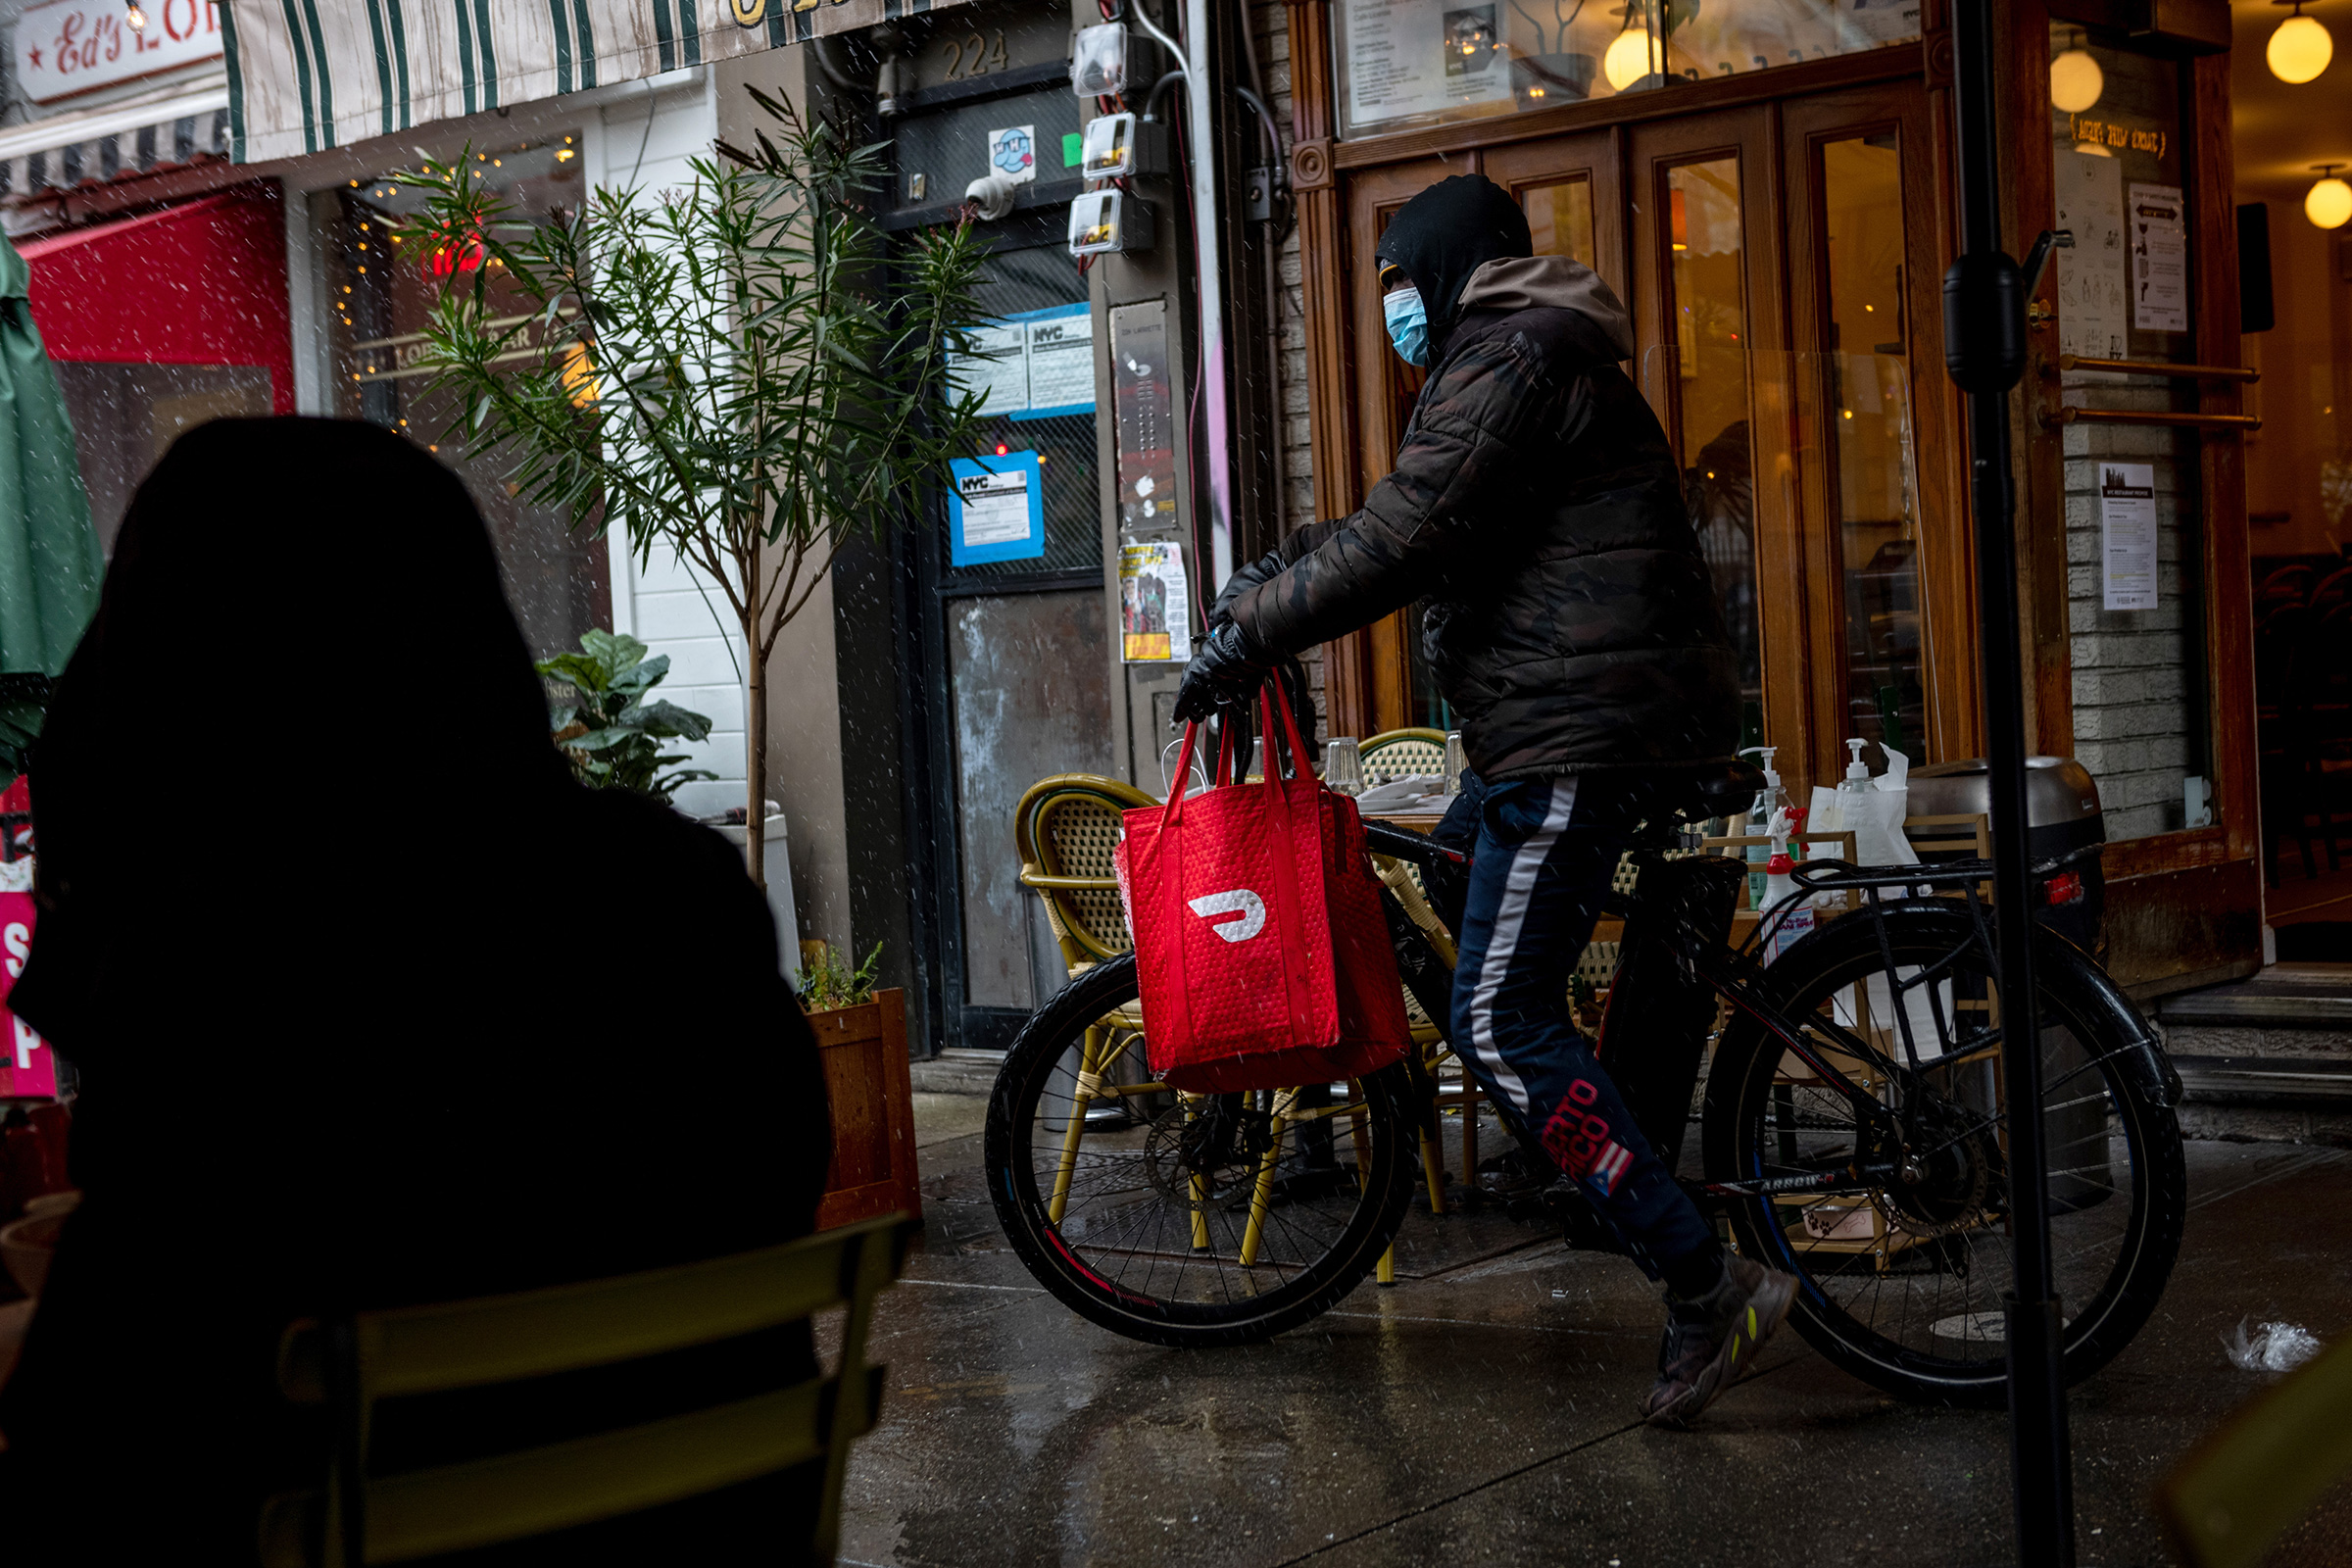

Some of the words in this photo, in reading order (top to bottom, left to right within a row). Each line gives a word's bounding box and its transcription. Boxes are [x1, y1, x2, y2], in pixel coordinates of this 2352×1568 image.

[54, 12, 122, 74] Ed's
[943, 33, 1008, 81] 224
[1034, 325, 1063, 343] NYC
[962, 476, 989, 491] NYC
